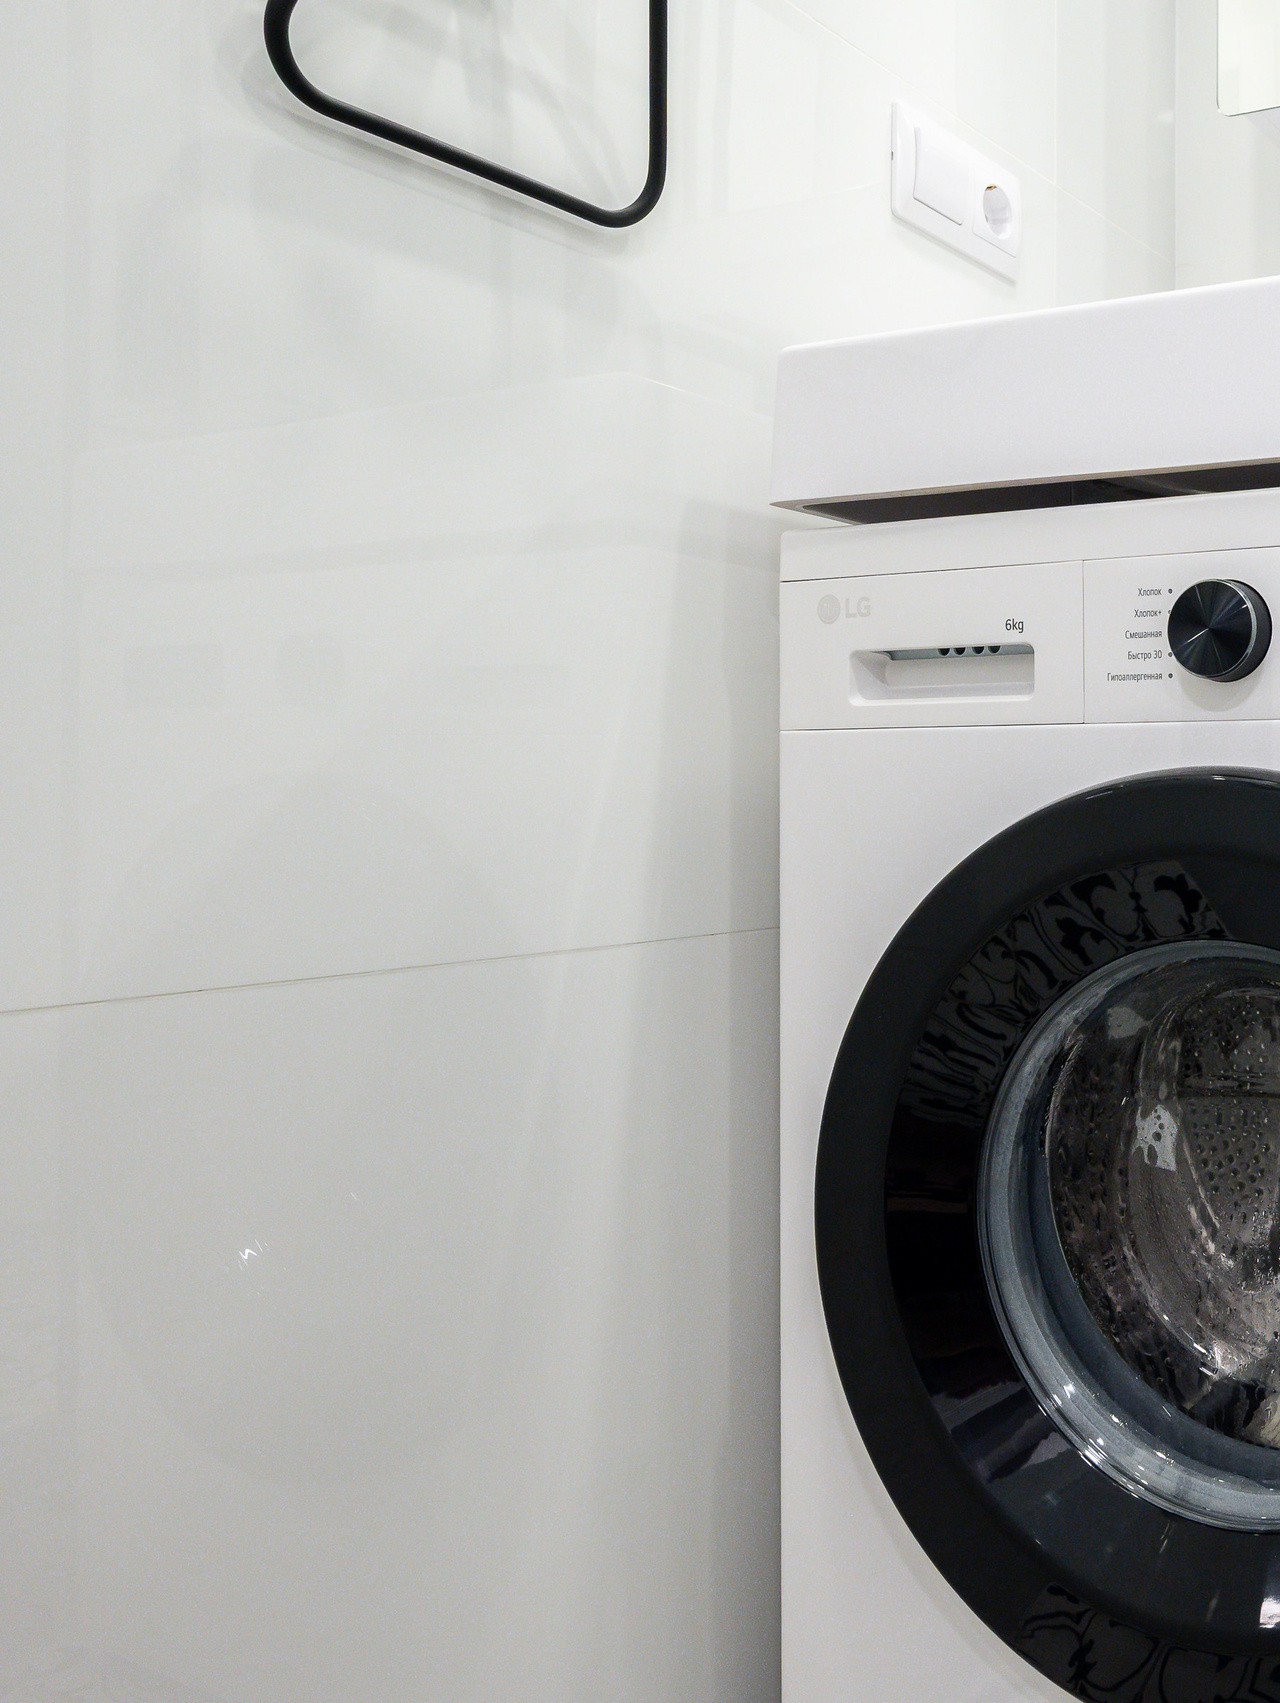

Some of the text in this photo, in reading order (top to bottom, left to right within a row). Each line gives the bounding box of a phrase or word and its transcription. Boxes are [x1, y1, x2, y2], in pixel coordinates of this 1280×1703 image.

[1137, 588, 1162, 597] Хлопок
[845, 596, 871, 619] LG
[1134, 609, 1162, 618] Хлопок+
[1005, 618, 1025, 633] 6kg
[1125, 630, 1162, 639] Смешанная
[1127, 650, 1162, 661] Быстро 30
[1107, 672, 1163, 682] Гипоаллергенная
